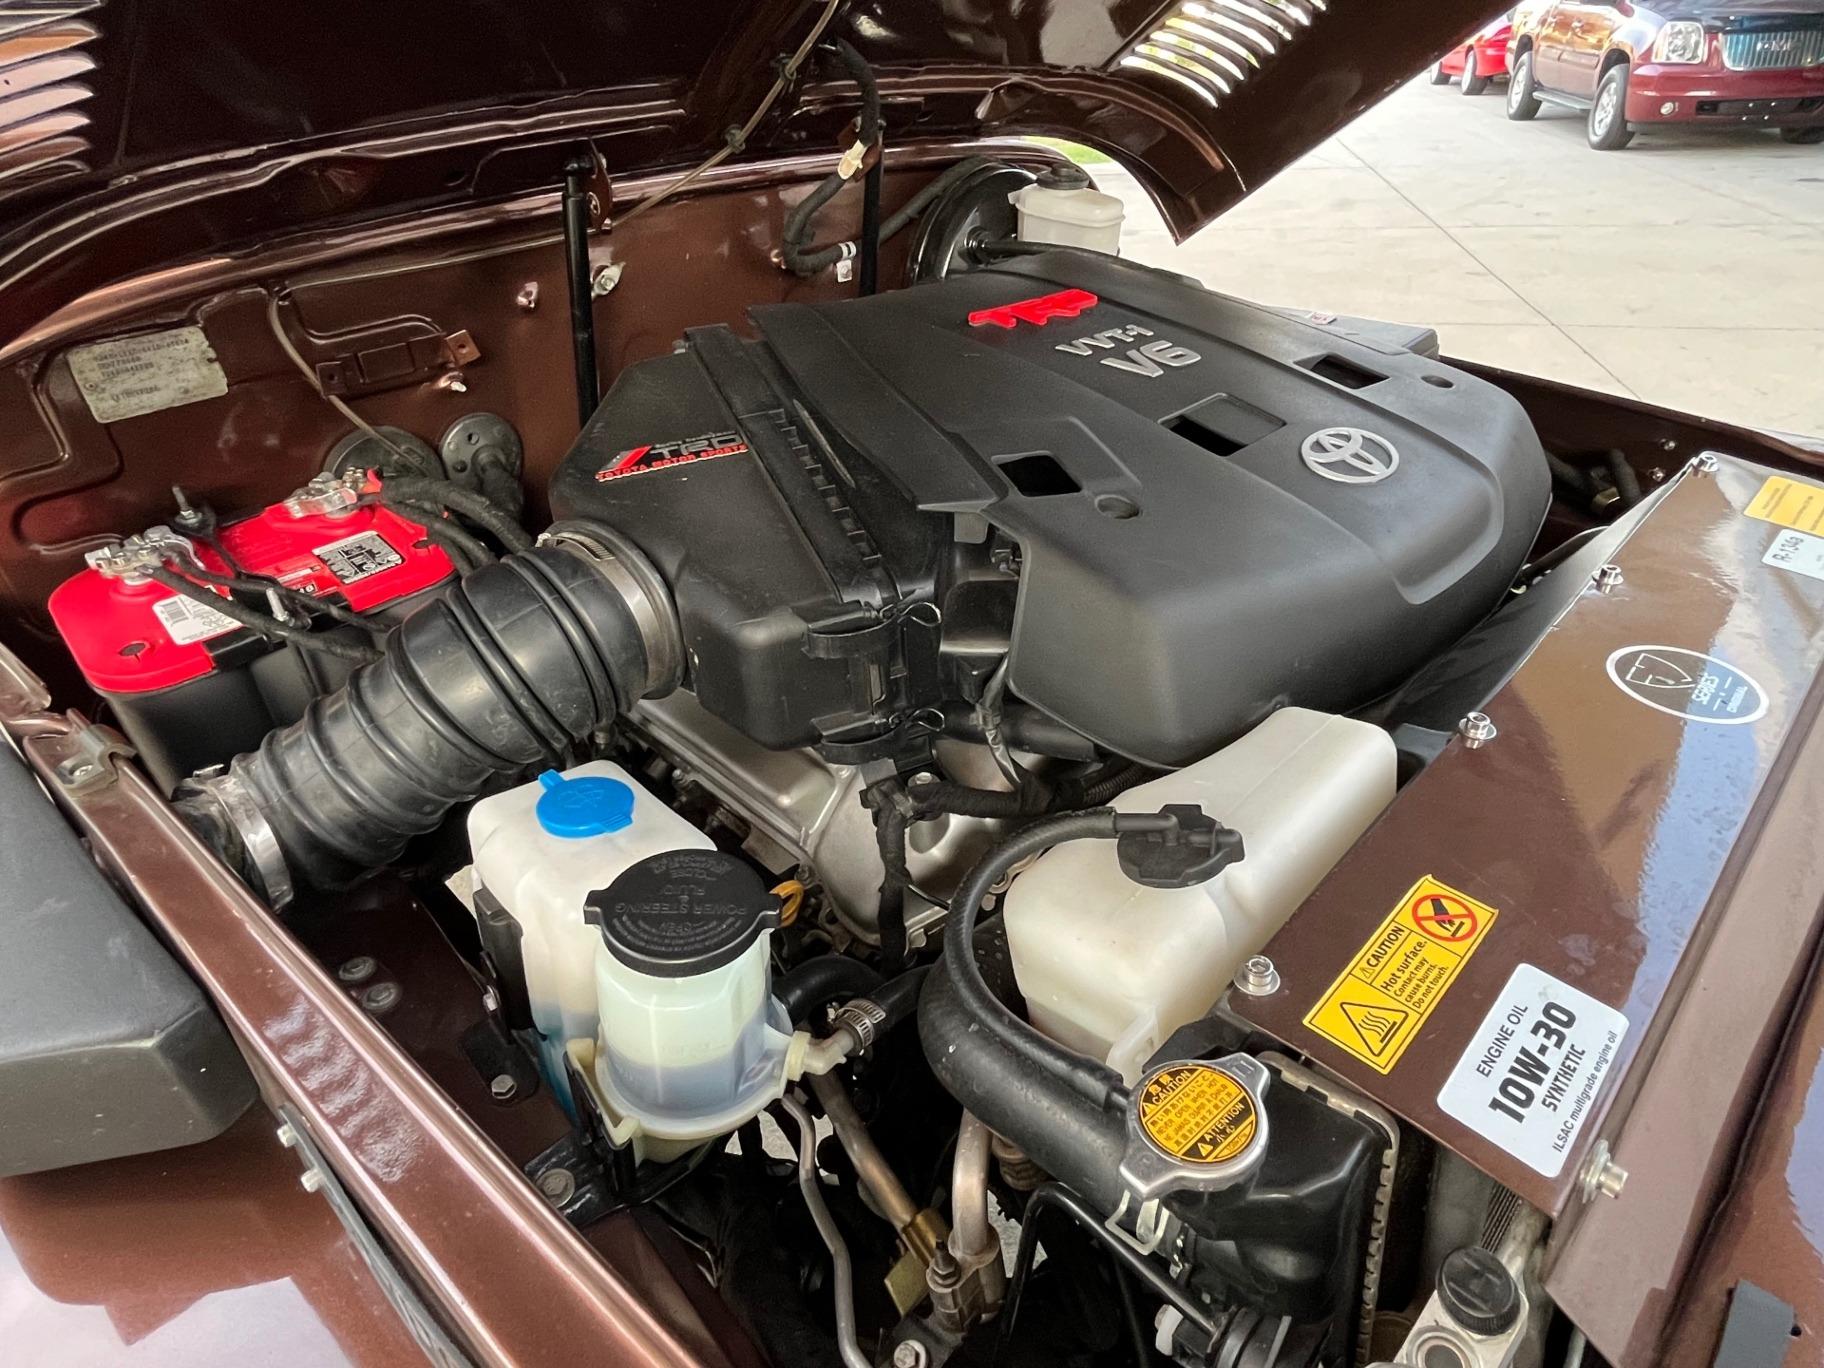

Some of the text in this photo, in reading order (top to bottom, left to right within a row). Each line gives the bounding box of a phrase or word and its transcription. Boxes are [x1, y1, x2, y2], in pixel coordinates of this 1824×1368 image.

[1100, 340, 1202, 378] V6
[599, 444, 748, 480] TOYOTA MOTOR SPORTS
[650, 434, 743, 459] TRD
[615, 902, 748, 915] POWER STEERING
[1366, 925, 1405, 968] CAUTION
[1381, 941, 1428, 992] Hot surface.
[1394, 957, 1429, 997] Contact may
[1405, 964, 1438, 1003] cause burns.
[1412, 966, 1449, 1009] Do not touch.
[1476, 1004, 1529, 1078] ENGINE OIL
[1488, 1001, 1576, 1124] 10W-30
[1541, 1043, 1586, 1112] SYNTHETIC
[1152, 1070, 1191, 1105] CAUTION
[1156, 1077, 1219, 1136] NEVER OPEN WHEN HOT
[1552, 1030, 1618, 1153] ILSAC multigrade engine oil
[1203, 1102, 1245, 1142] ATTENTION
